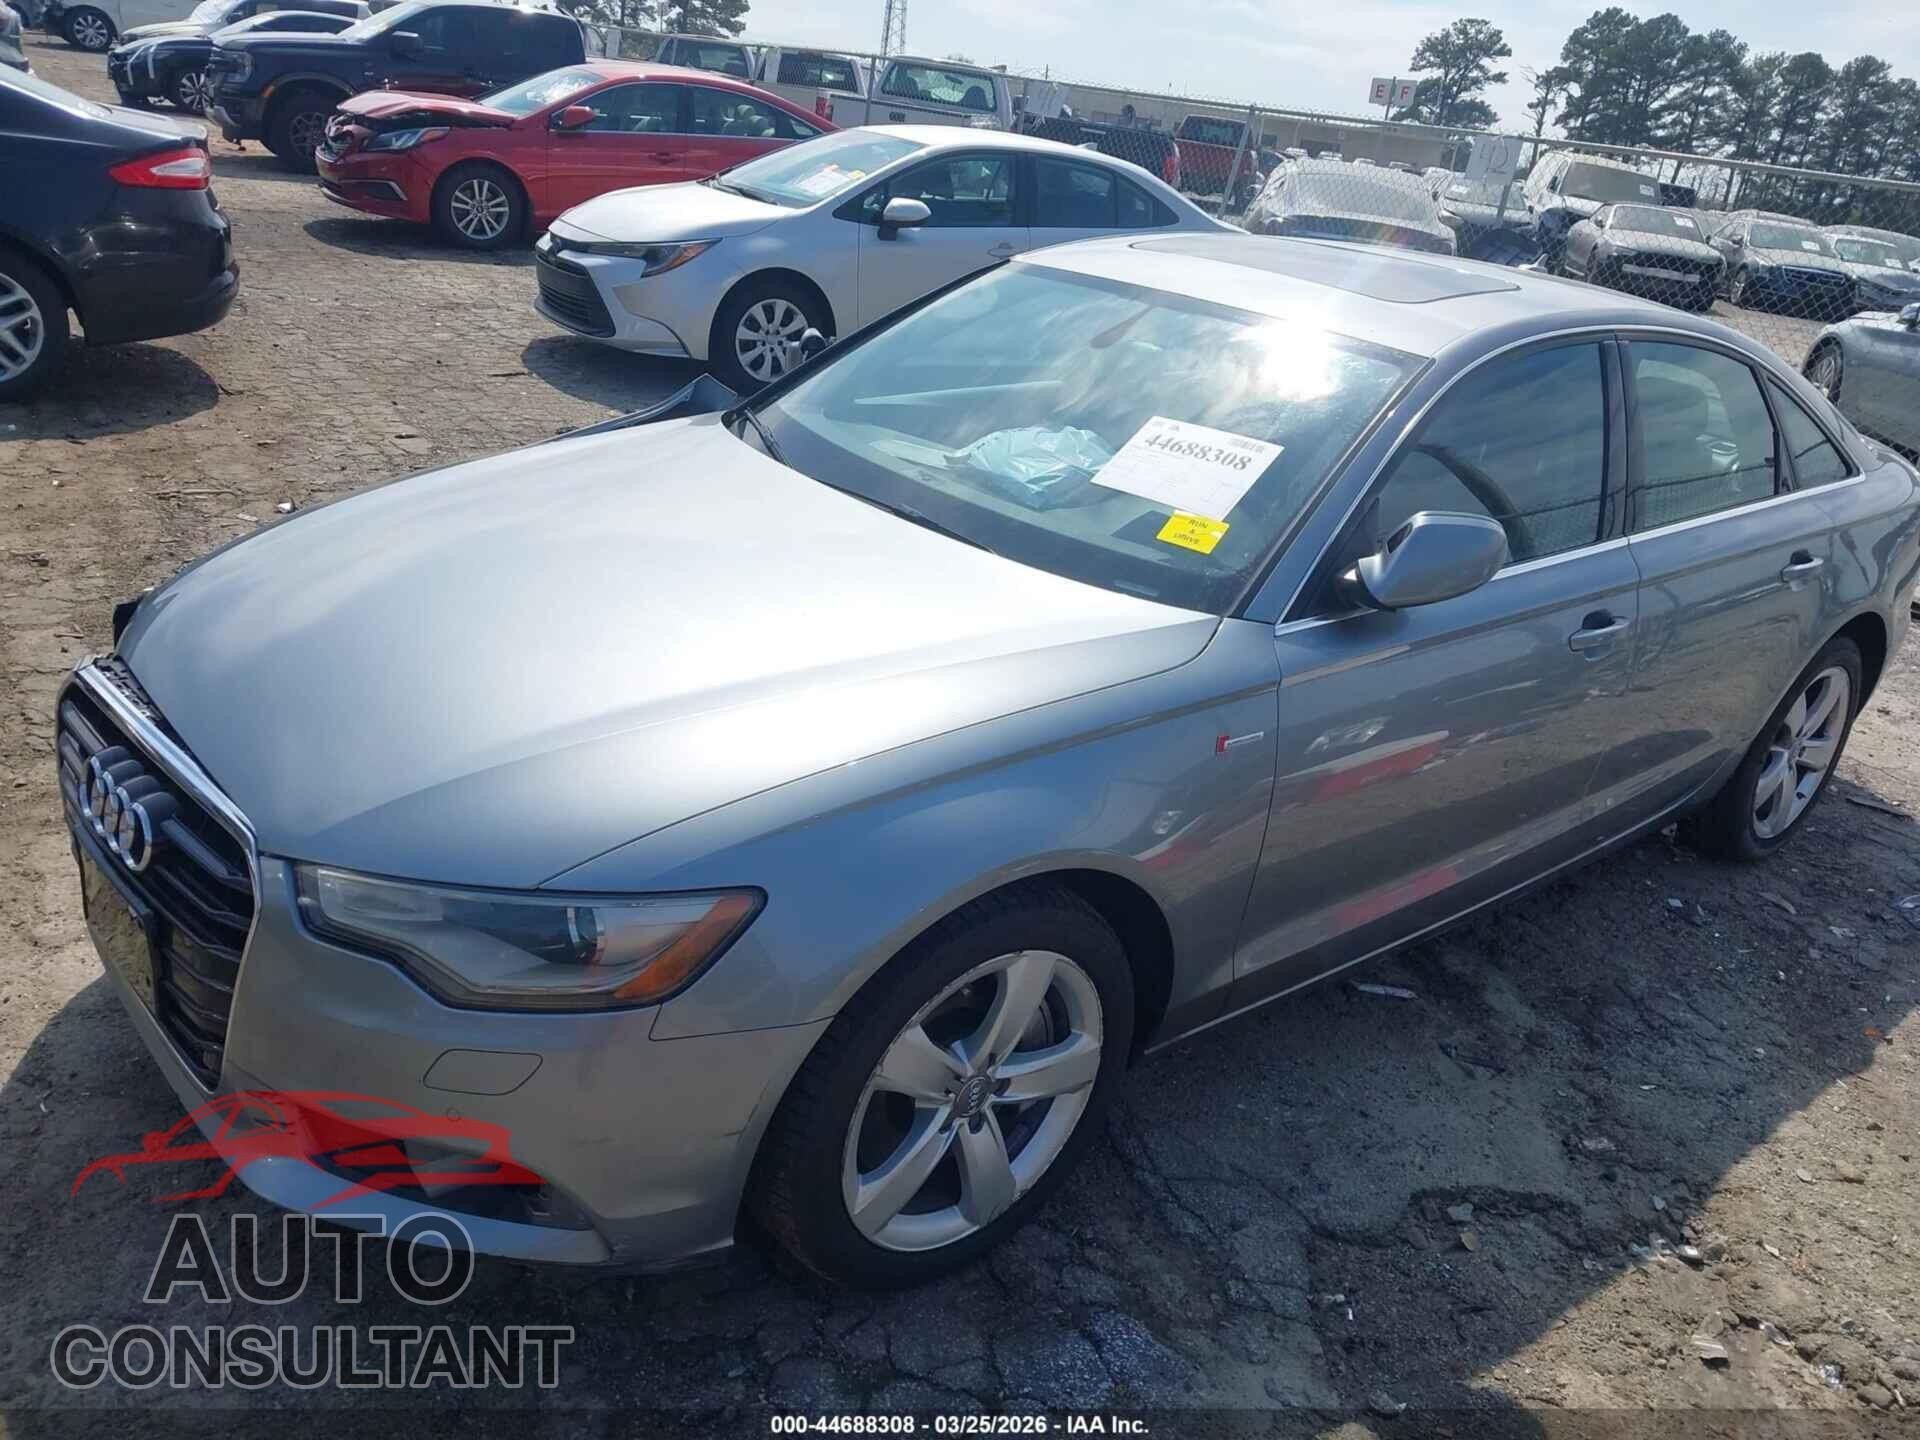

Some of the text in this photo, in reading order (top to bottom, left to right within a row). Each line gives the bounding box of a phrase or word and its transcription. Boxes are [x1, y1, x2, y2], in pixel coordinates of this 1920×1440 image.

[1375, 84, 1411, 100] E F
[1145, 434, 1252, 471] 44688308
